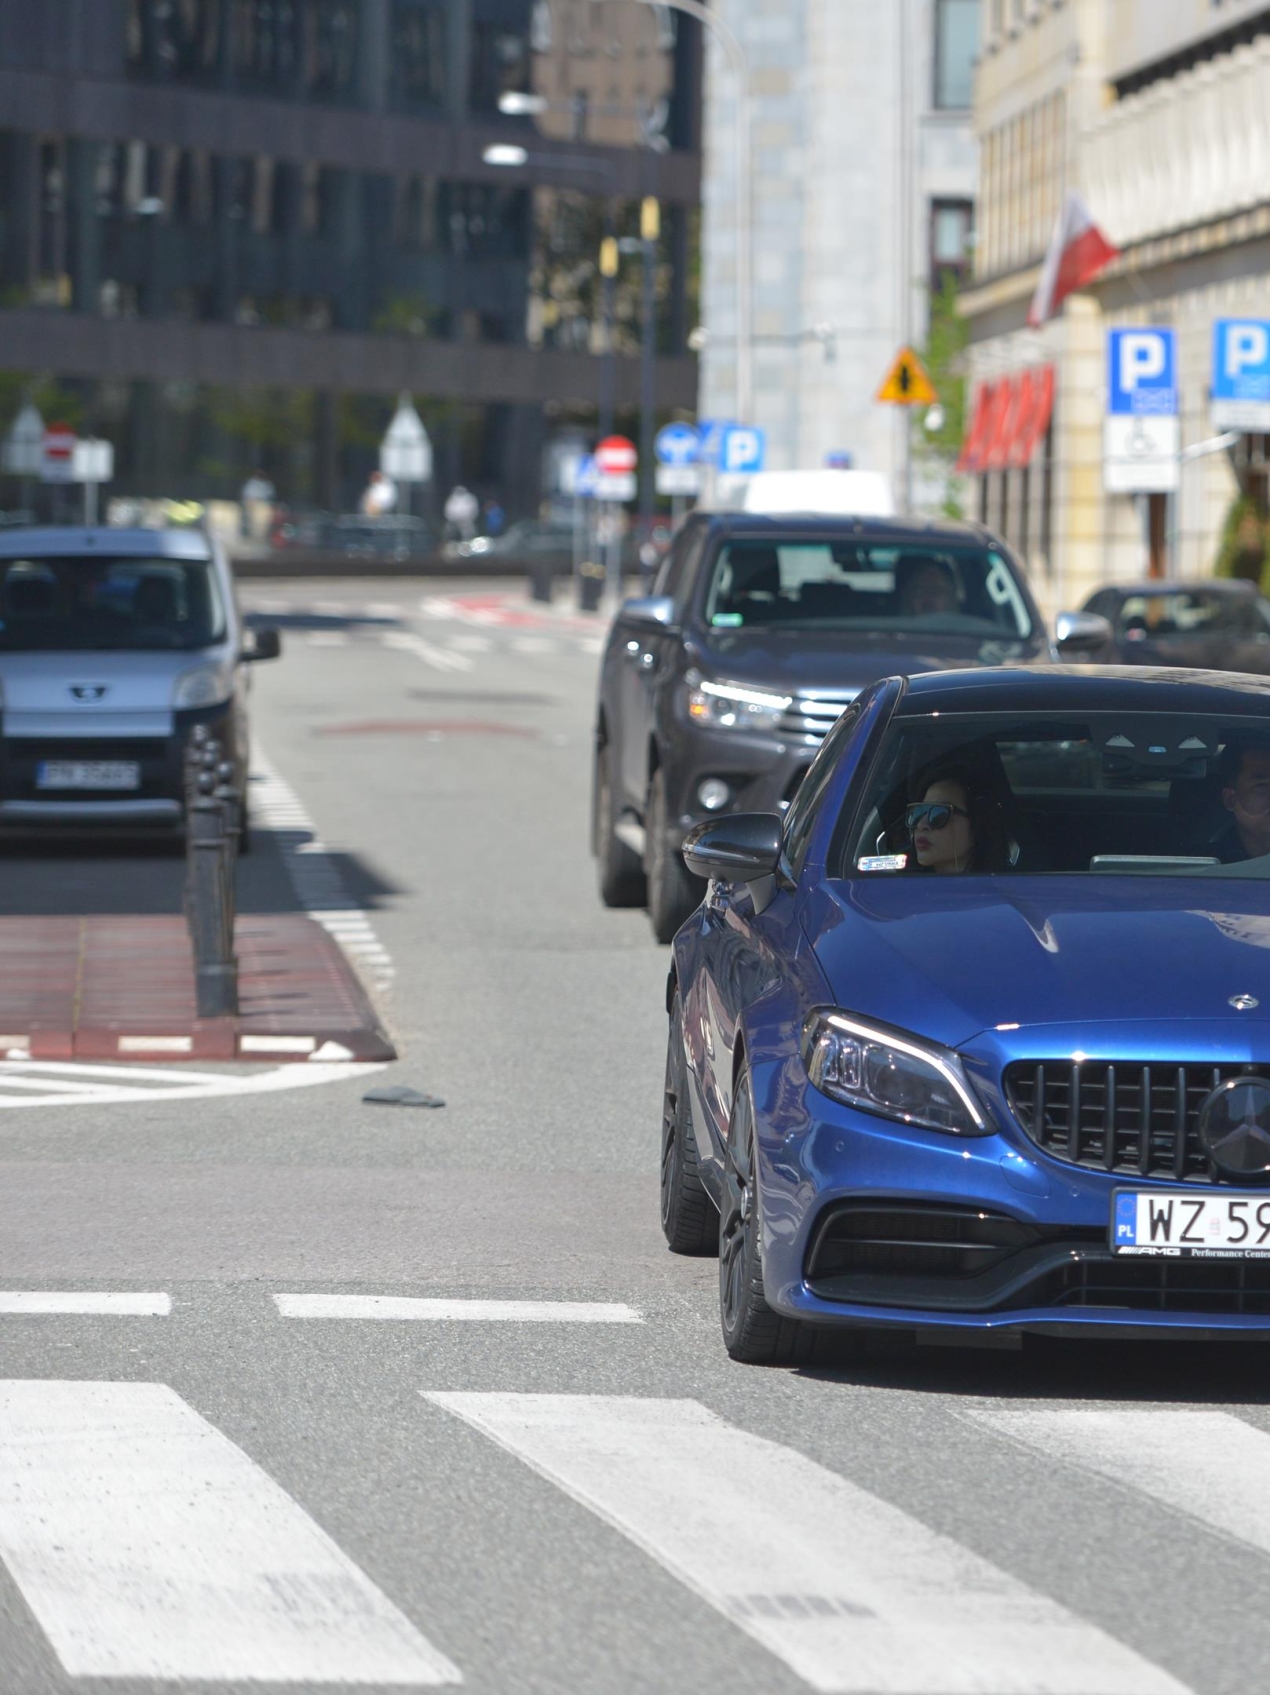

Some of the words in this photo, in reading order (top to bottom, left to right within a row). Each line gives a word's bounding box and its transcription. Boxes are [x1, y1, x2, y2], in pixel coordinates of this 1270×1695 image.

[1119, 332, 1166, 392] P
[1225, 324, 1268, 377] P
[726, 430, 759, 471] P
[1117, 1225, 1135, 1237] PL
[1148, 1199, 1205, 1243] WZ
[1139, 1247, 1181, 1256] AMG
[1191, 1248, 1244, 1258] Performance
[1245, 1250, 1270, 1258] Center
